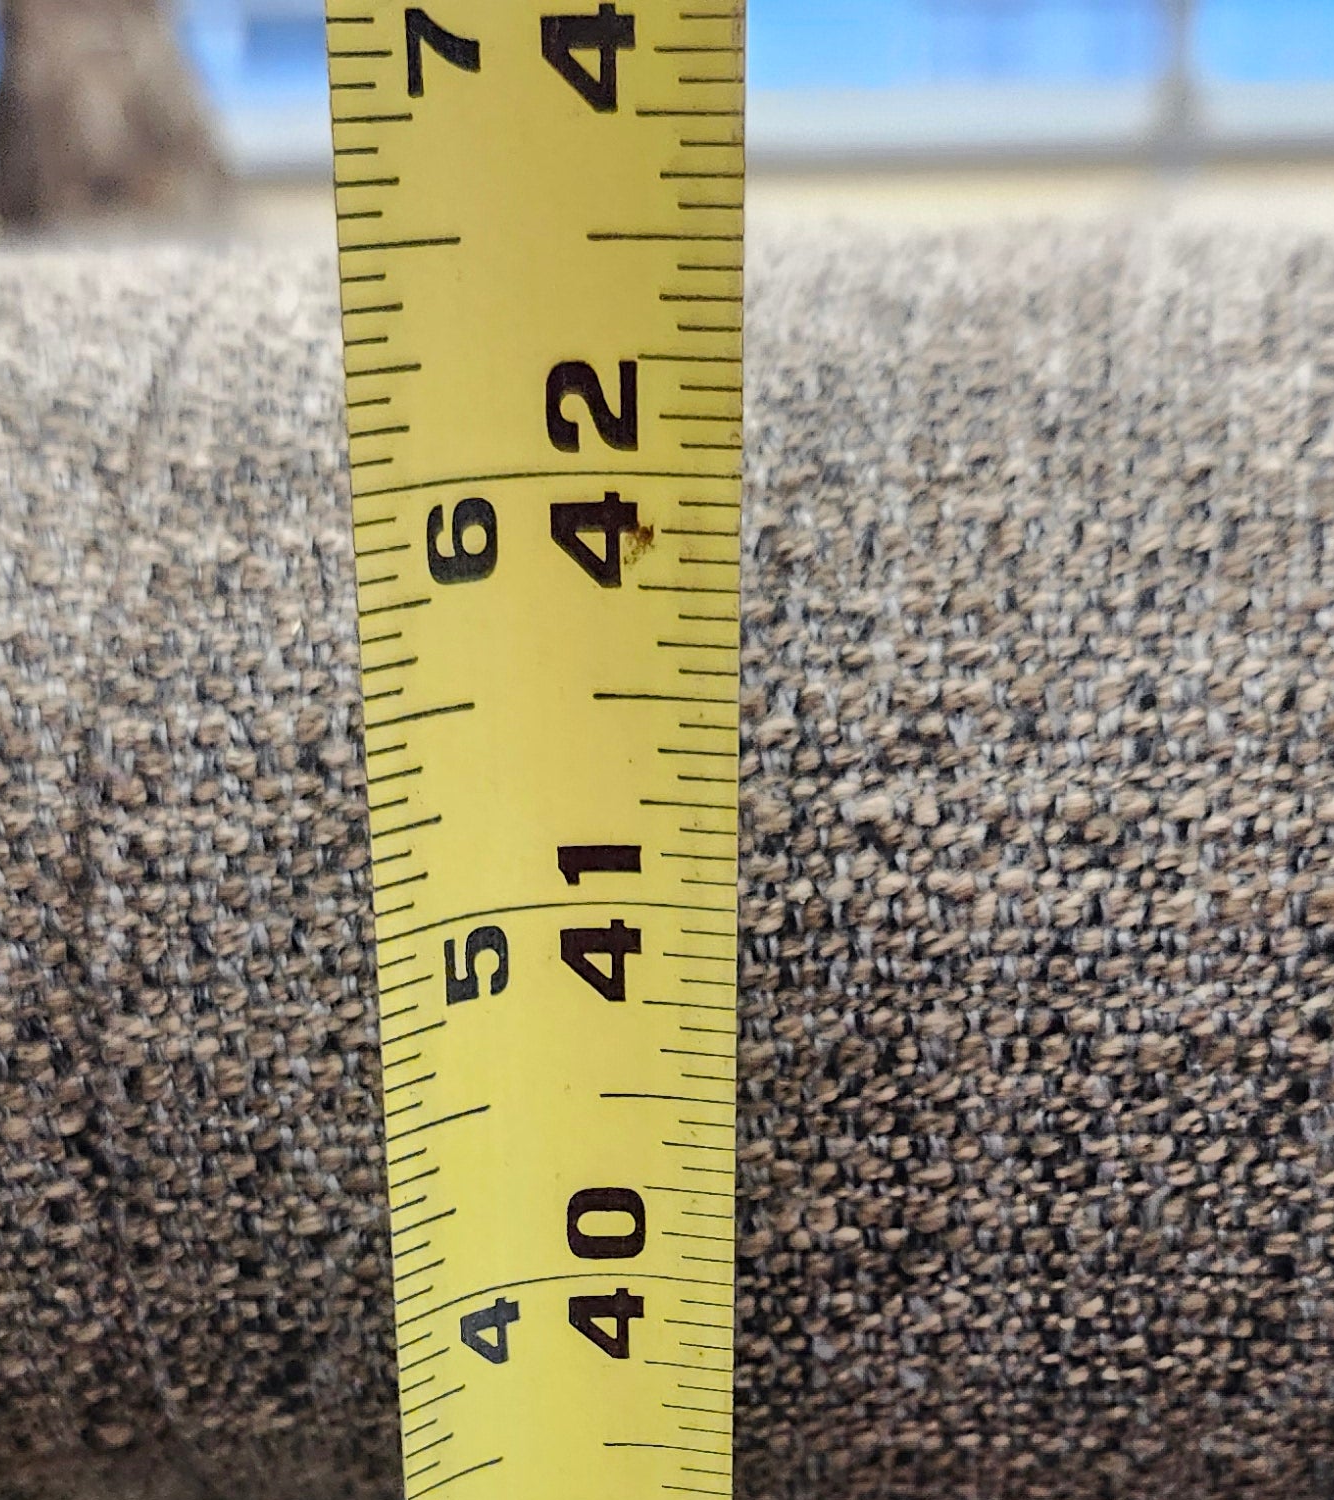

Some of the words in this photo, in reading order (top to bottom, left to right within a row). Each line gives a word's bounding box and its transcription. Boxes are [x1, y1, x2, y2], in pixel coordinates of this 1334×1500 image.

[404, 8, 481, 98] 7
[545, 360, 639, 589] 42
[426, 497, 498, 586] 6
[443, 925, 509, 1006] 5
[557, 845, 643, 1003] 41
[567, 1187, 646, 1359] 40
[460, 1297, 520, 1364] 4
